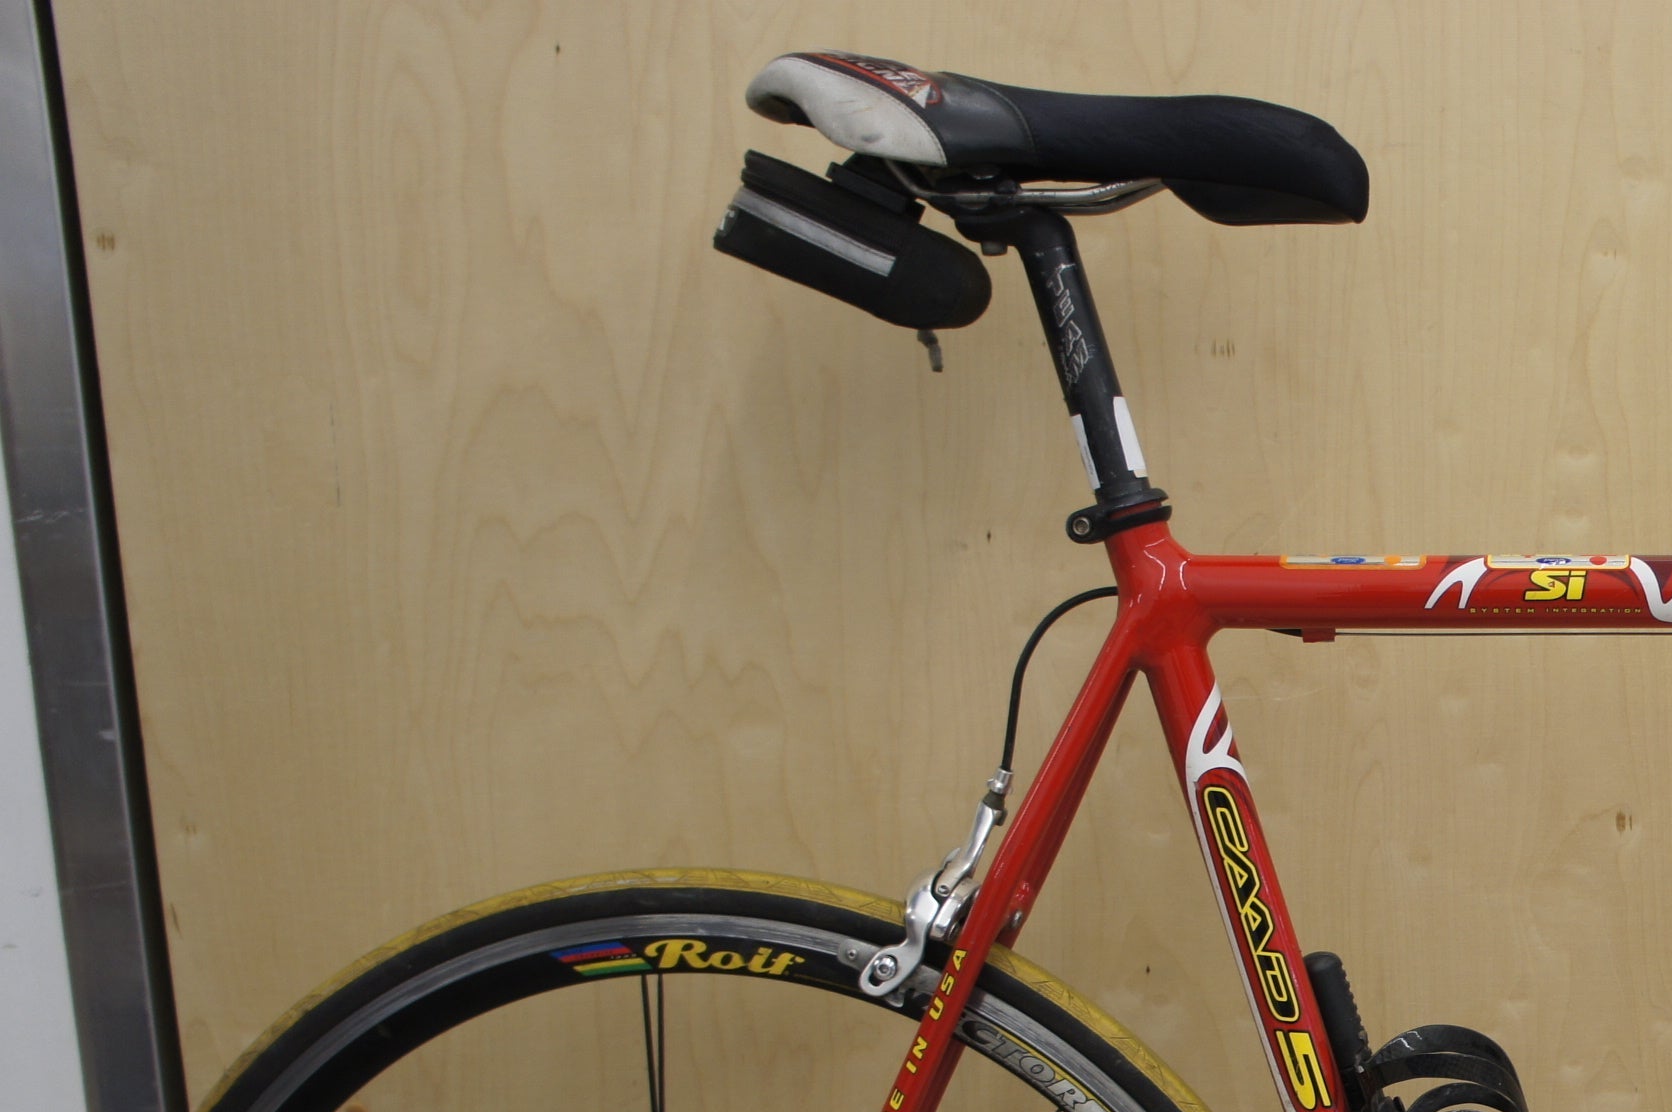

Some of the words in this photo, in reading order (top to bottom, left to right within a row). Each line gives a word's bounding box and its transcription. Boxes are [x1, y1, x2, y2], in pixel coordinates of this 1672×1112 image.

[1523, 570, 1588, 601] Si
[1469, 607, 1536, 615] SYSTEM
[1545, 606, 1643, 615] INTEGRATION
[644, 938, 806, 976] Rolf
[906, 1037, 927, 1074] IN
[928, 948, 968, 1021] USA
